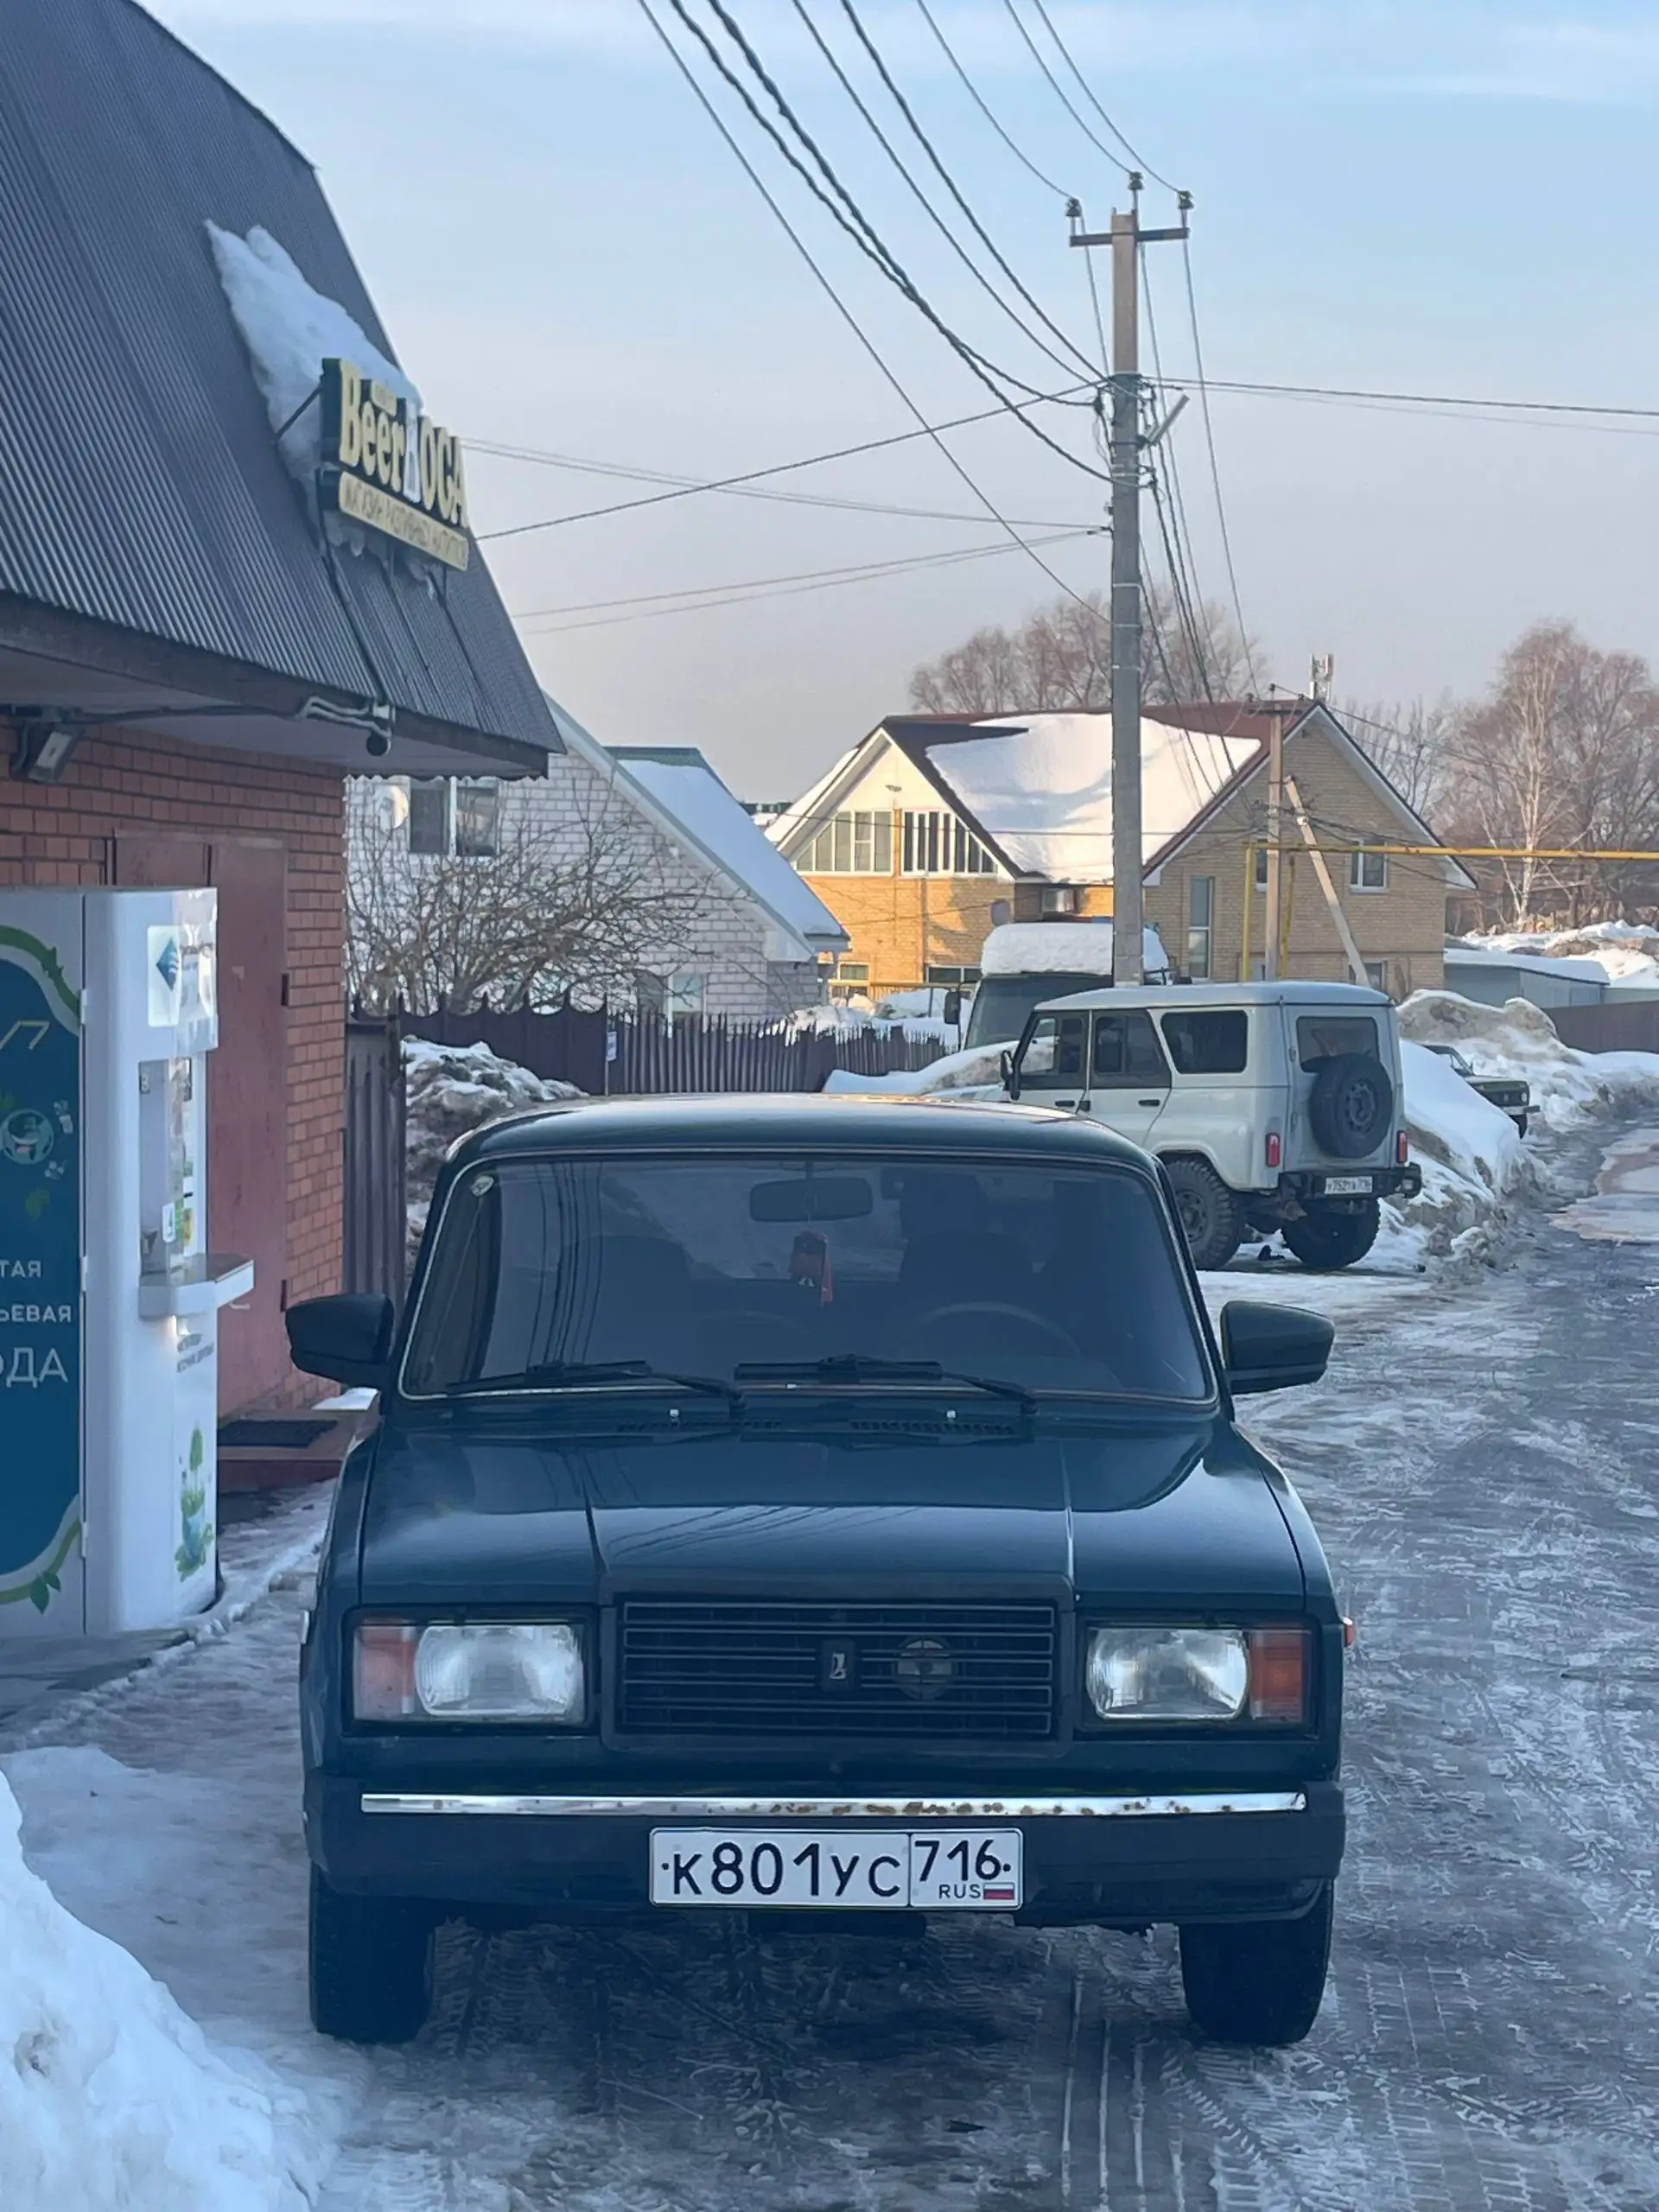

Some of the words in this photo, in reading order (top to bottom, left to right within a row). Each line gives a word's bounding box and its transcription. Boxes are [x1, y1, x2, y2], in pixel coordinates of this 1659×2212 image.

[0, 1259, 41, 1278] ТАЯ
[0, 1346, 68, 1389] ДА
[672, 1841, 901, 1897] К801УС
[914, 1839, 1001, 1882] 716
[938, 1884, 981, 1899] RUS
